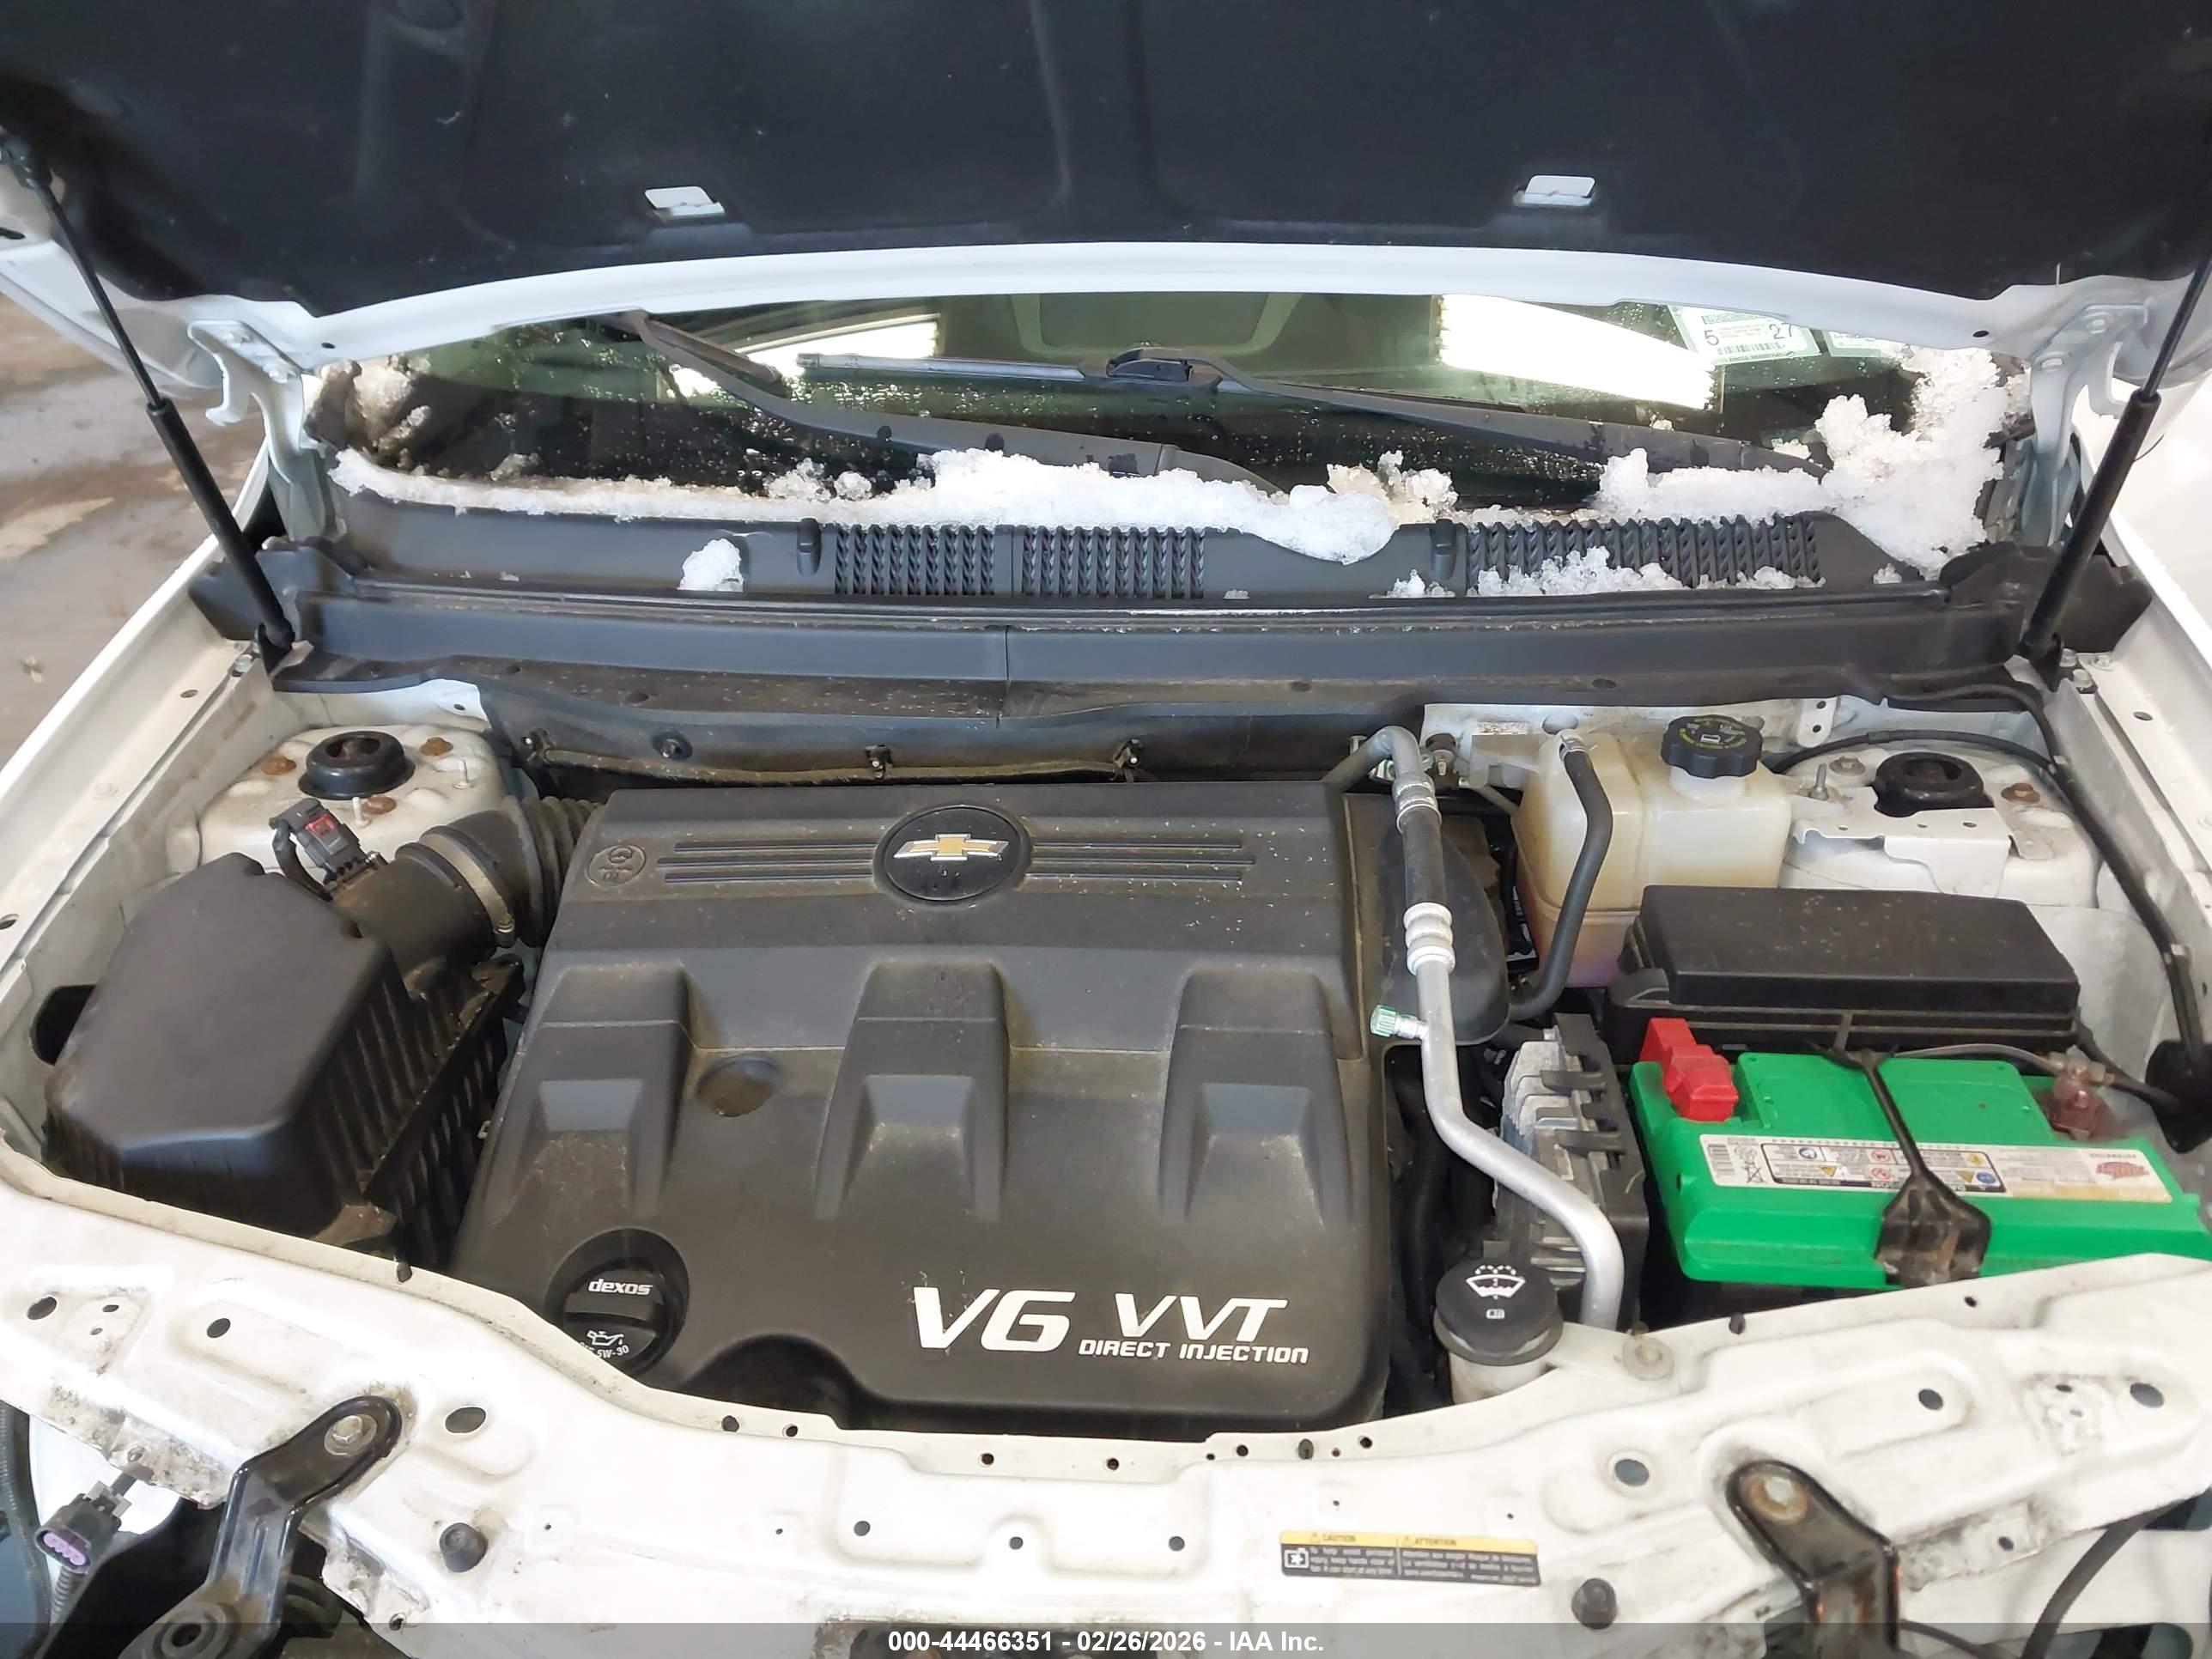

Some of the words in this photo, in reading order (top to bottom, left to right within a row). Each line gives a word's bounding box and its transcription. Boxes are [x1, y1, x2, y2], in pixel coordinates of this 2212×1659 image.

[1705, 329, 1720, 346] 5
[588, 1279, 653, 1295] dexos
[914, 1286, 1076, 1352] V6
[1115, 1292, 1288, 1341] VVT
[597, 1345, 629, 1358] 5W-30
[1079, 1339, 1171, 1359] DIRECT
[1179, 1342, 1309, 1364] INJECTION
